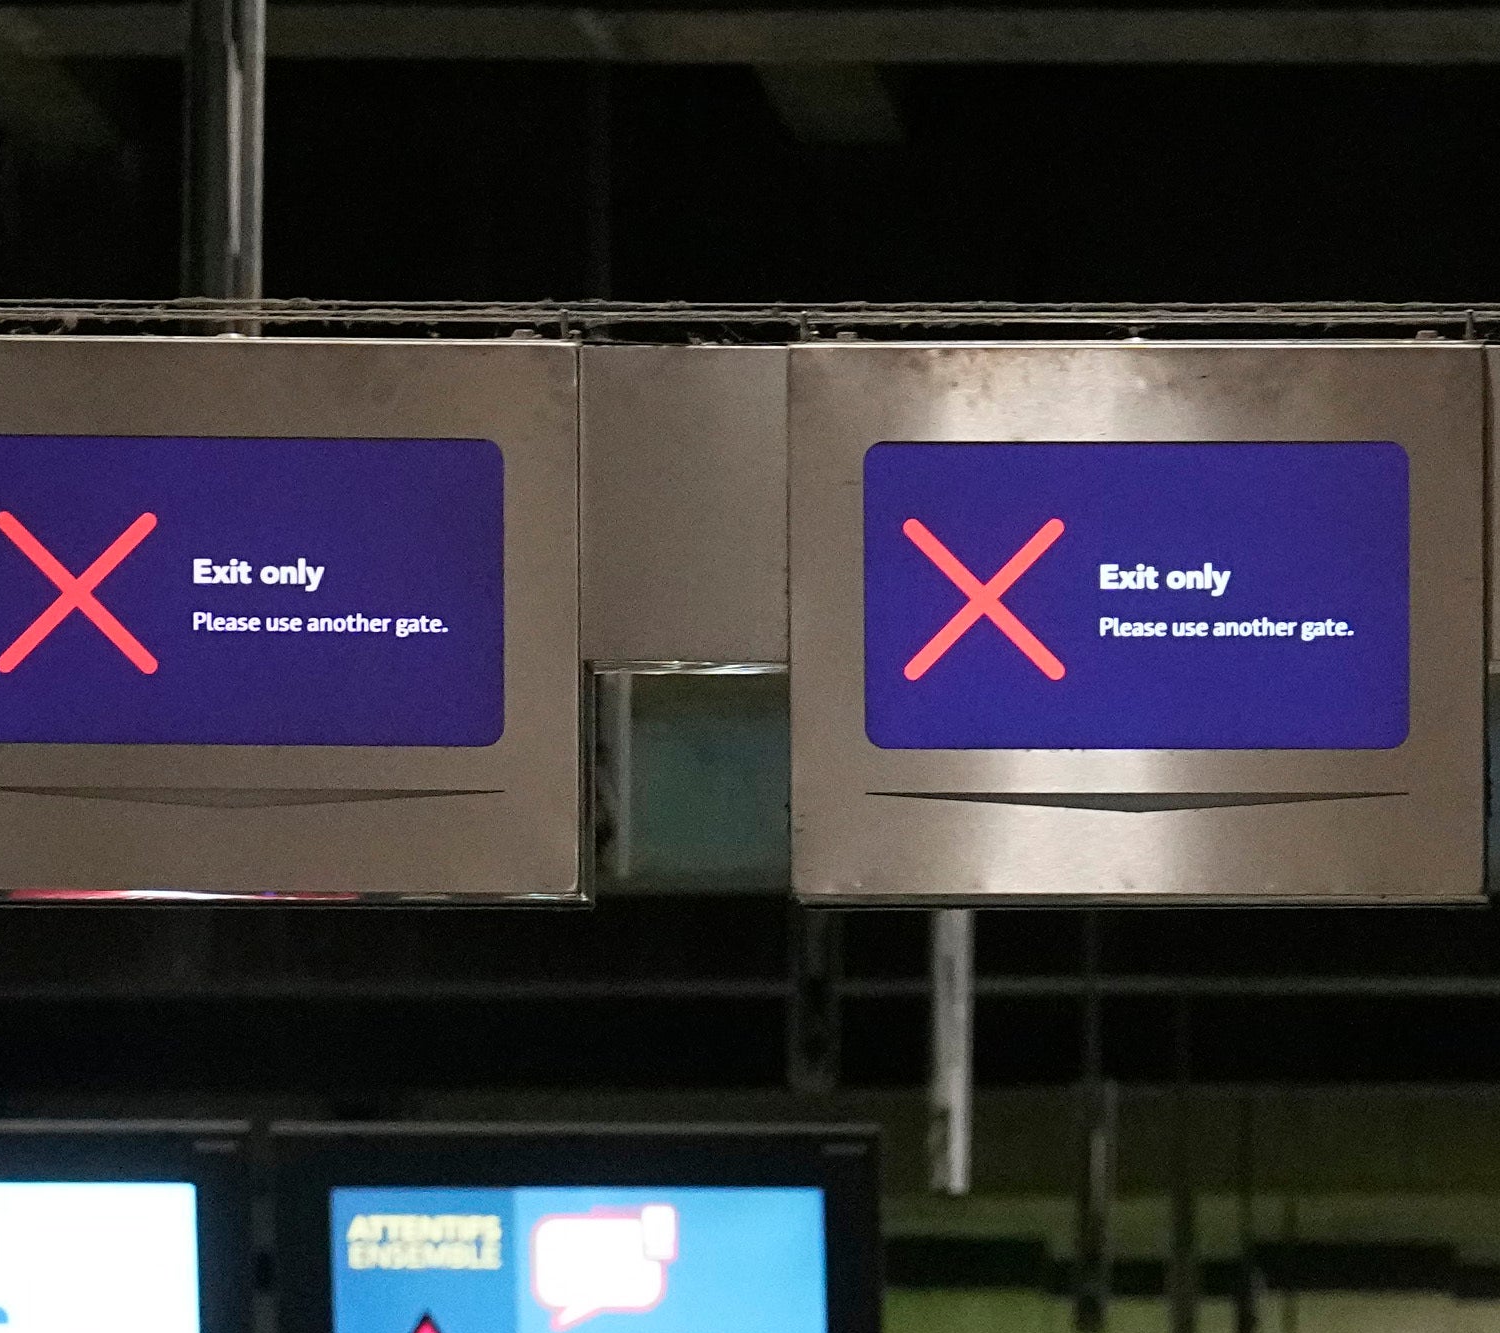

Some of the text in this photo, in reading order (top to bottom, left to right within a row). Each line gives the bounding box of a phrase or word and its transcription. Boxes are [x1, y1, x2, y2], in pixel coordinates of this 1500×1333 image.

[194, 558, 324, 591] Exit only
[1100, 563, 1231, 596] Exit only
[193, 612, 448, 637] Please use another gate.
[1100, 617, 1354, 641] Please use another gate.
